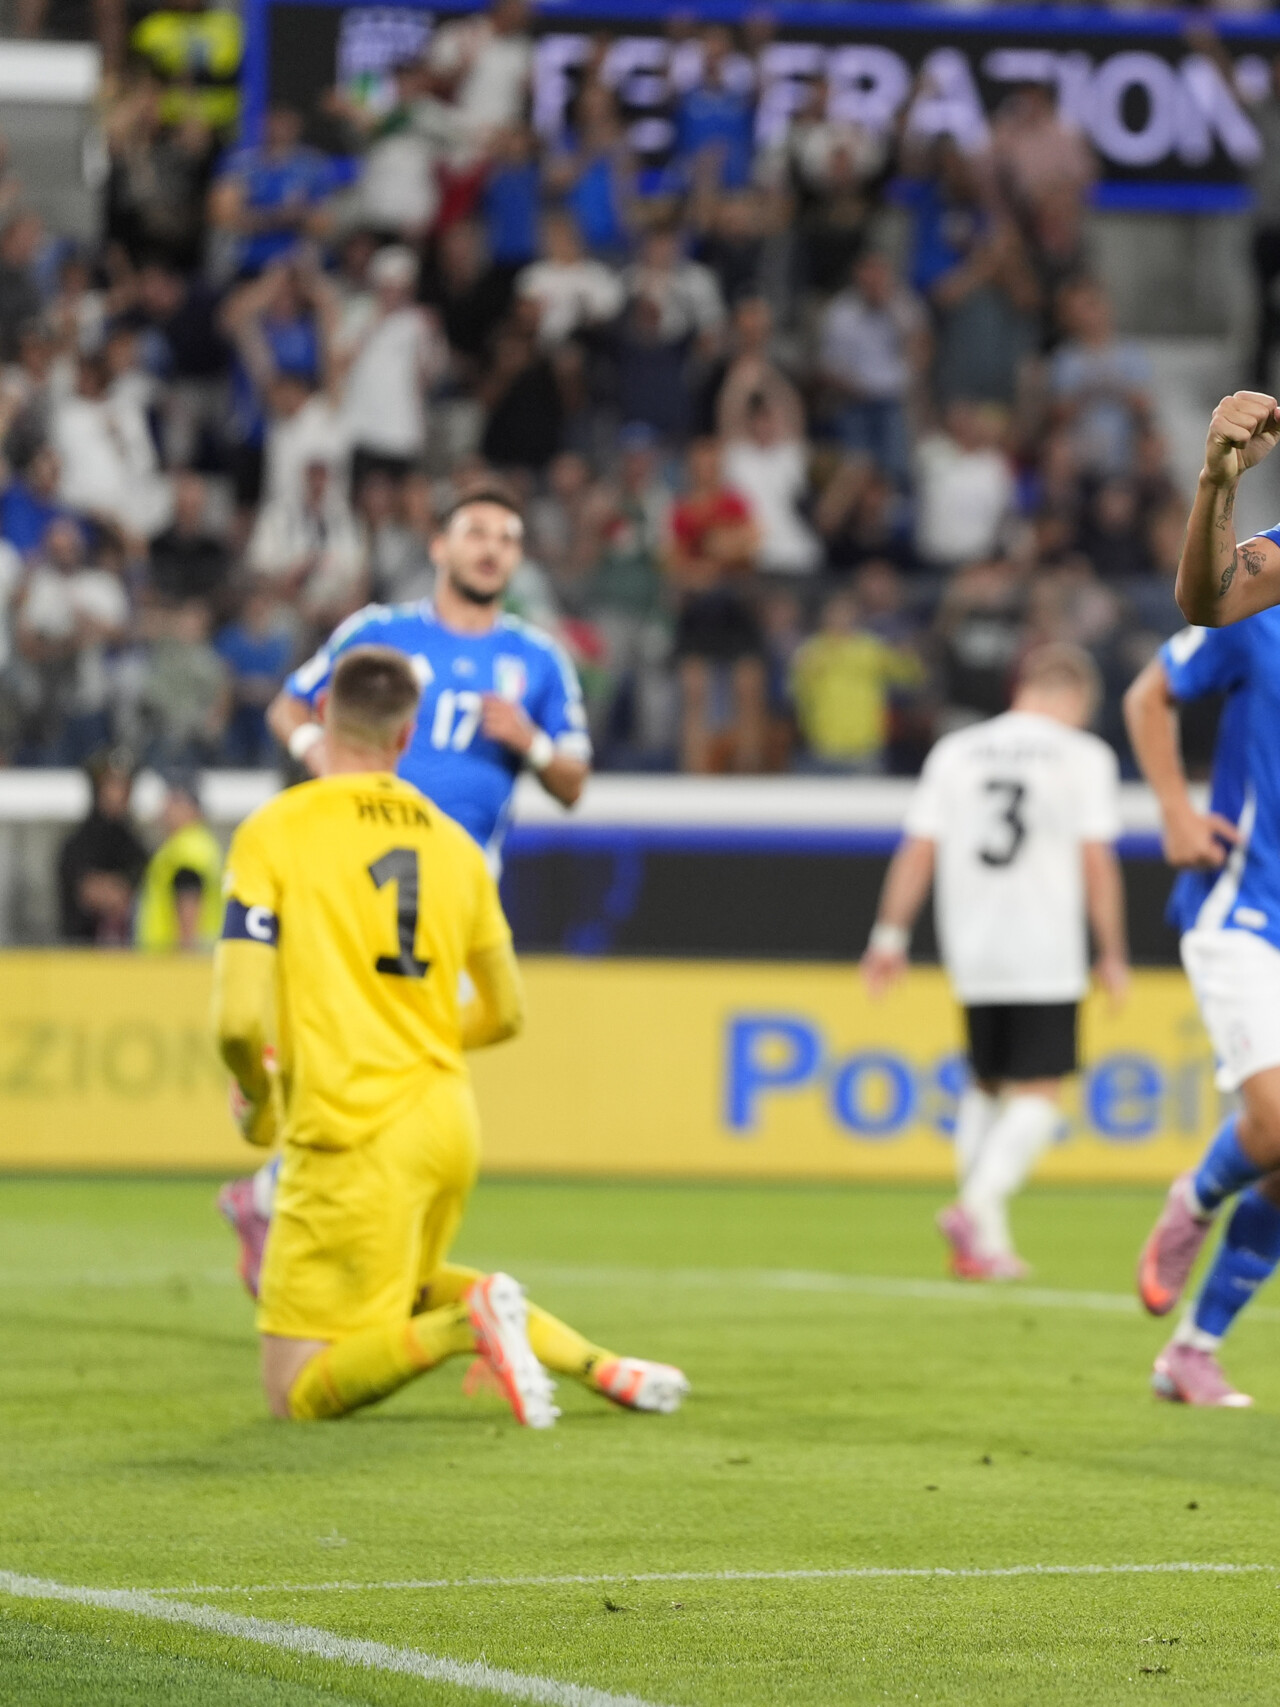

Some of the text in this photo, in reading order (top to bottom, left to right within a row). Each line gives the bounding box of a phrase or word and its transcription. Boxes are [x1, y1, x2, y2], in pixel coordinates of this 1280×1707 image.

[430, 687, 484, 752] 17
[979, 778, 1026, 866] 3
[244, 905, 273, 940] C
[367, 847, 431, 977] 1
